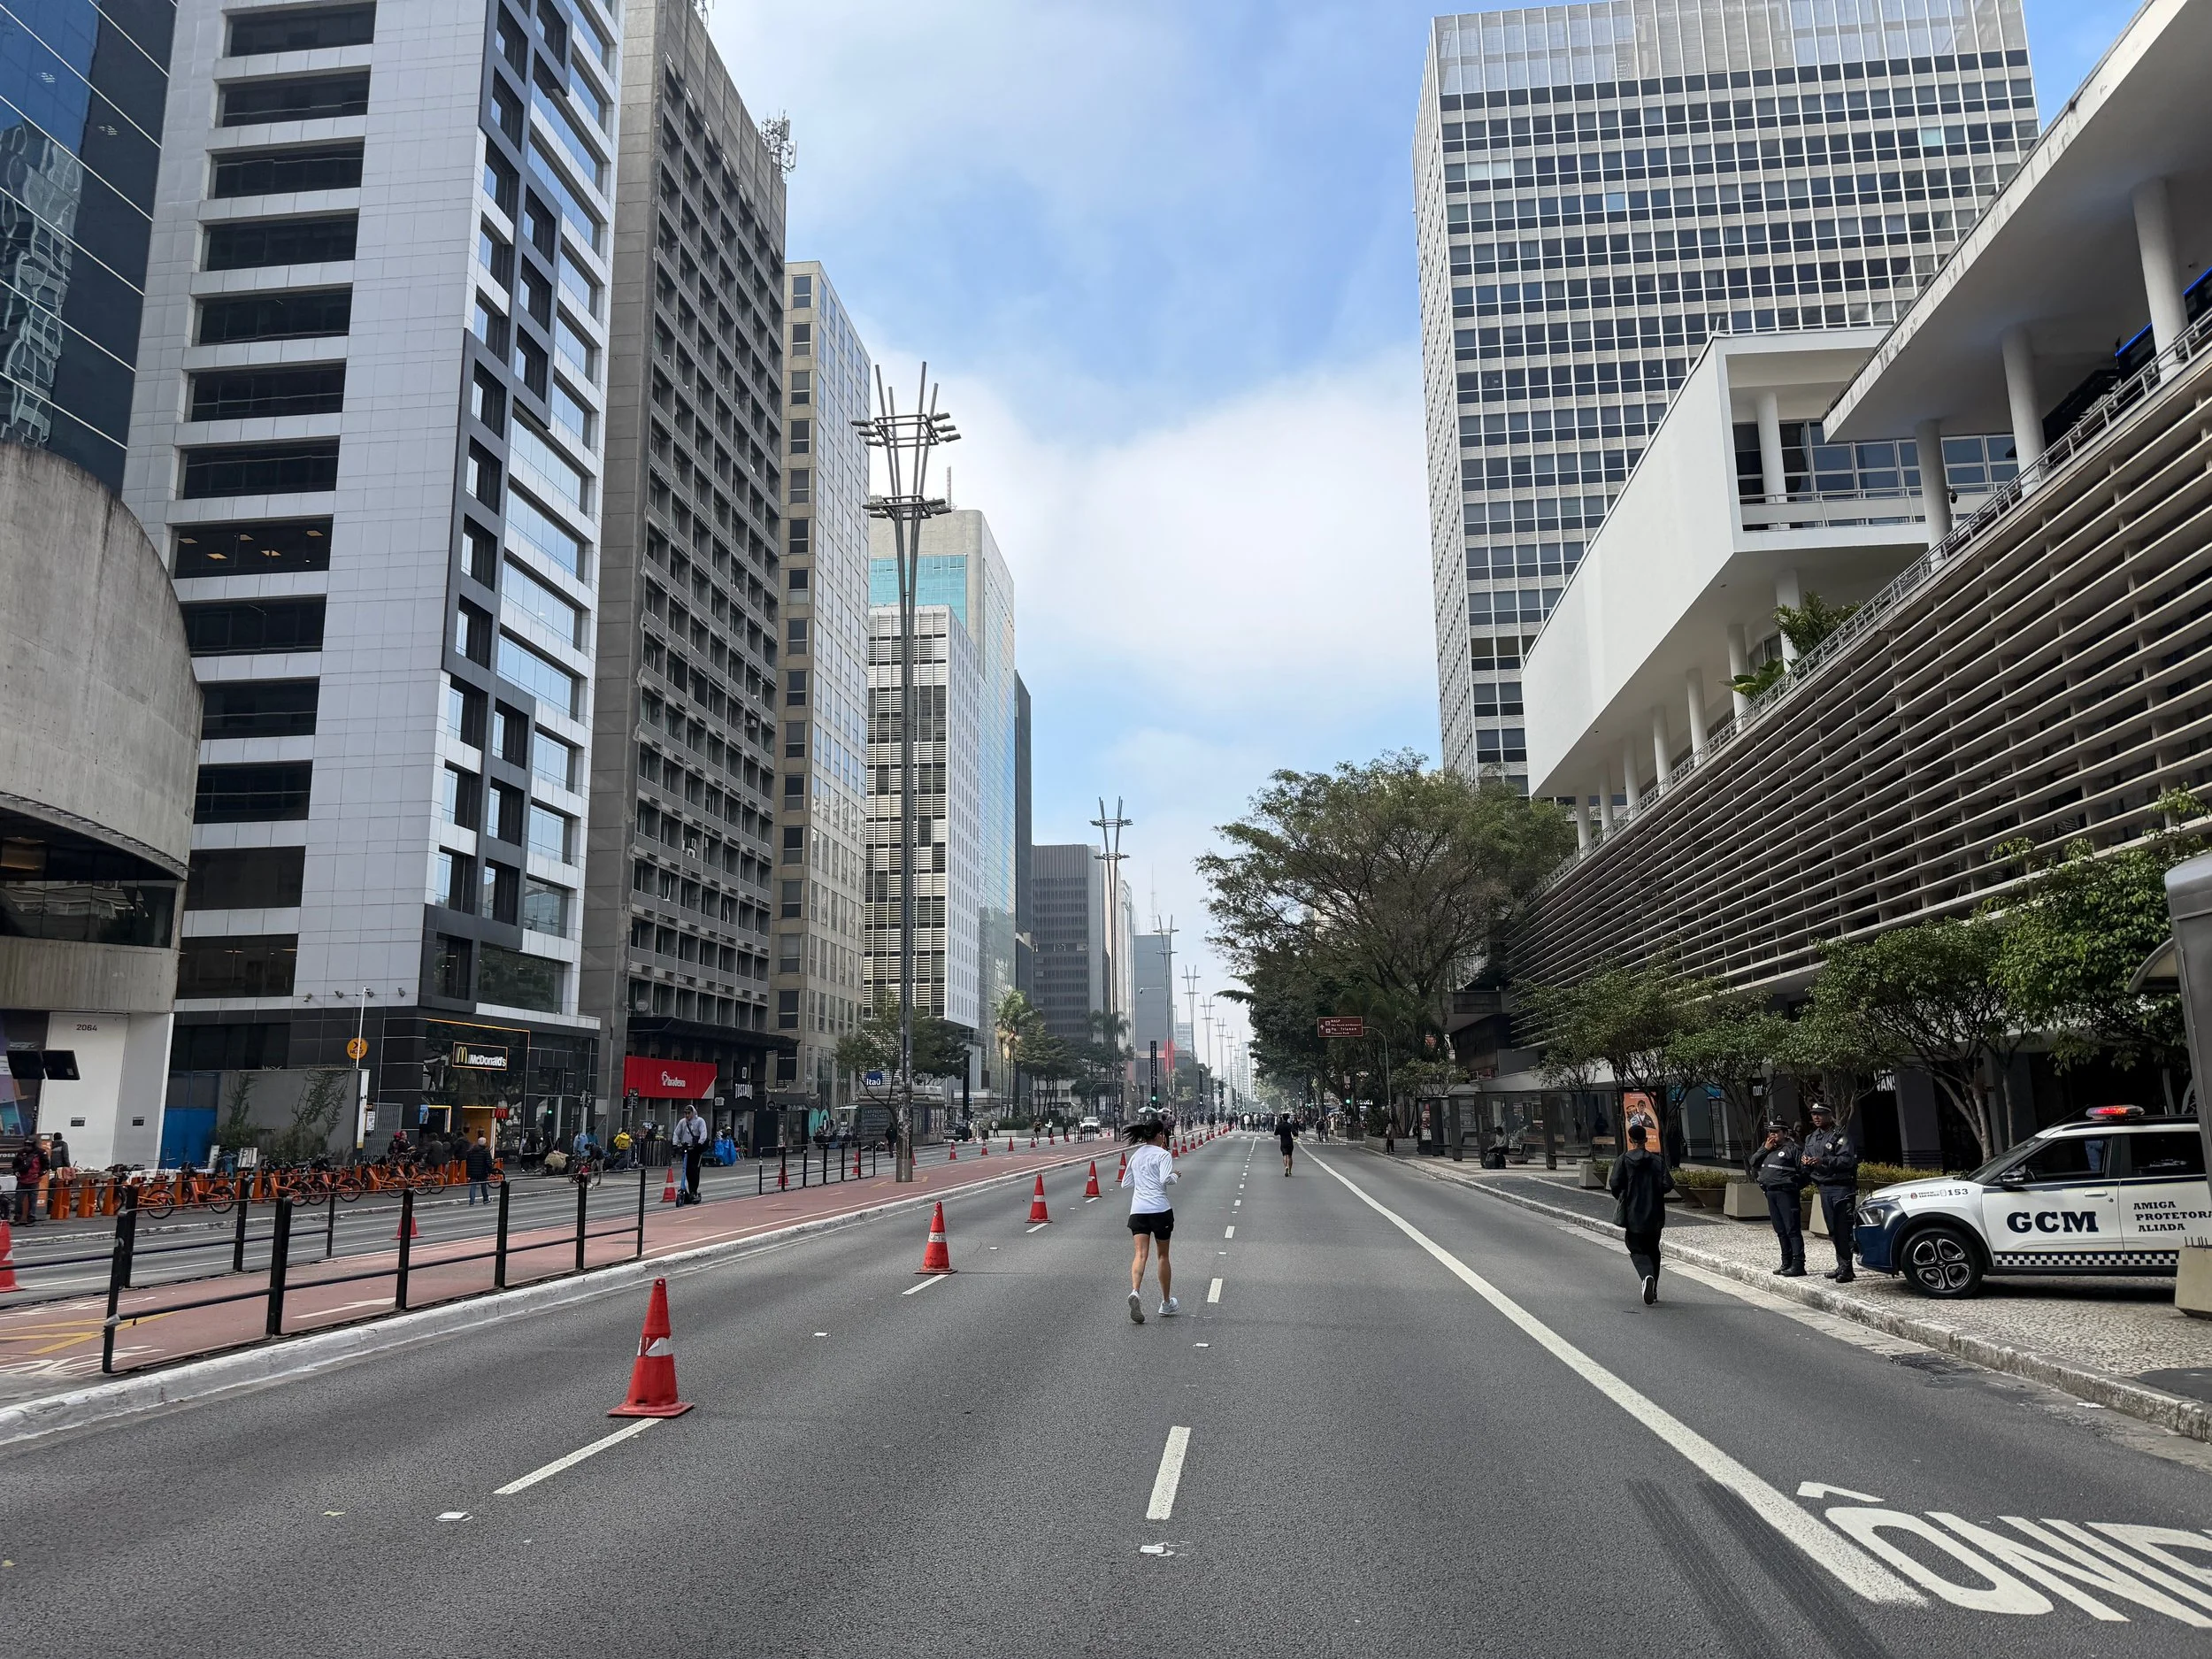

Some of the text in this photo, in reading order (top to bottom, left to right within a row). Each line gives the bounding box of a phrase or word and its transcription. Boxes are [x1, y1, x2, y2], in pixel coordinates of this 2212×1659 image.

[468, 1054, 507, 1067] McDonald's
[735, 1083, 753, 1100] TOSTADO
[2133, 1201, 2177, 1210] AMIGA
[2007, 1211, 2099, 1233] GCM
[2138, 1223, 2186, 1233] ALIADA
